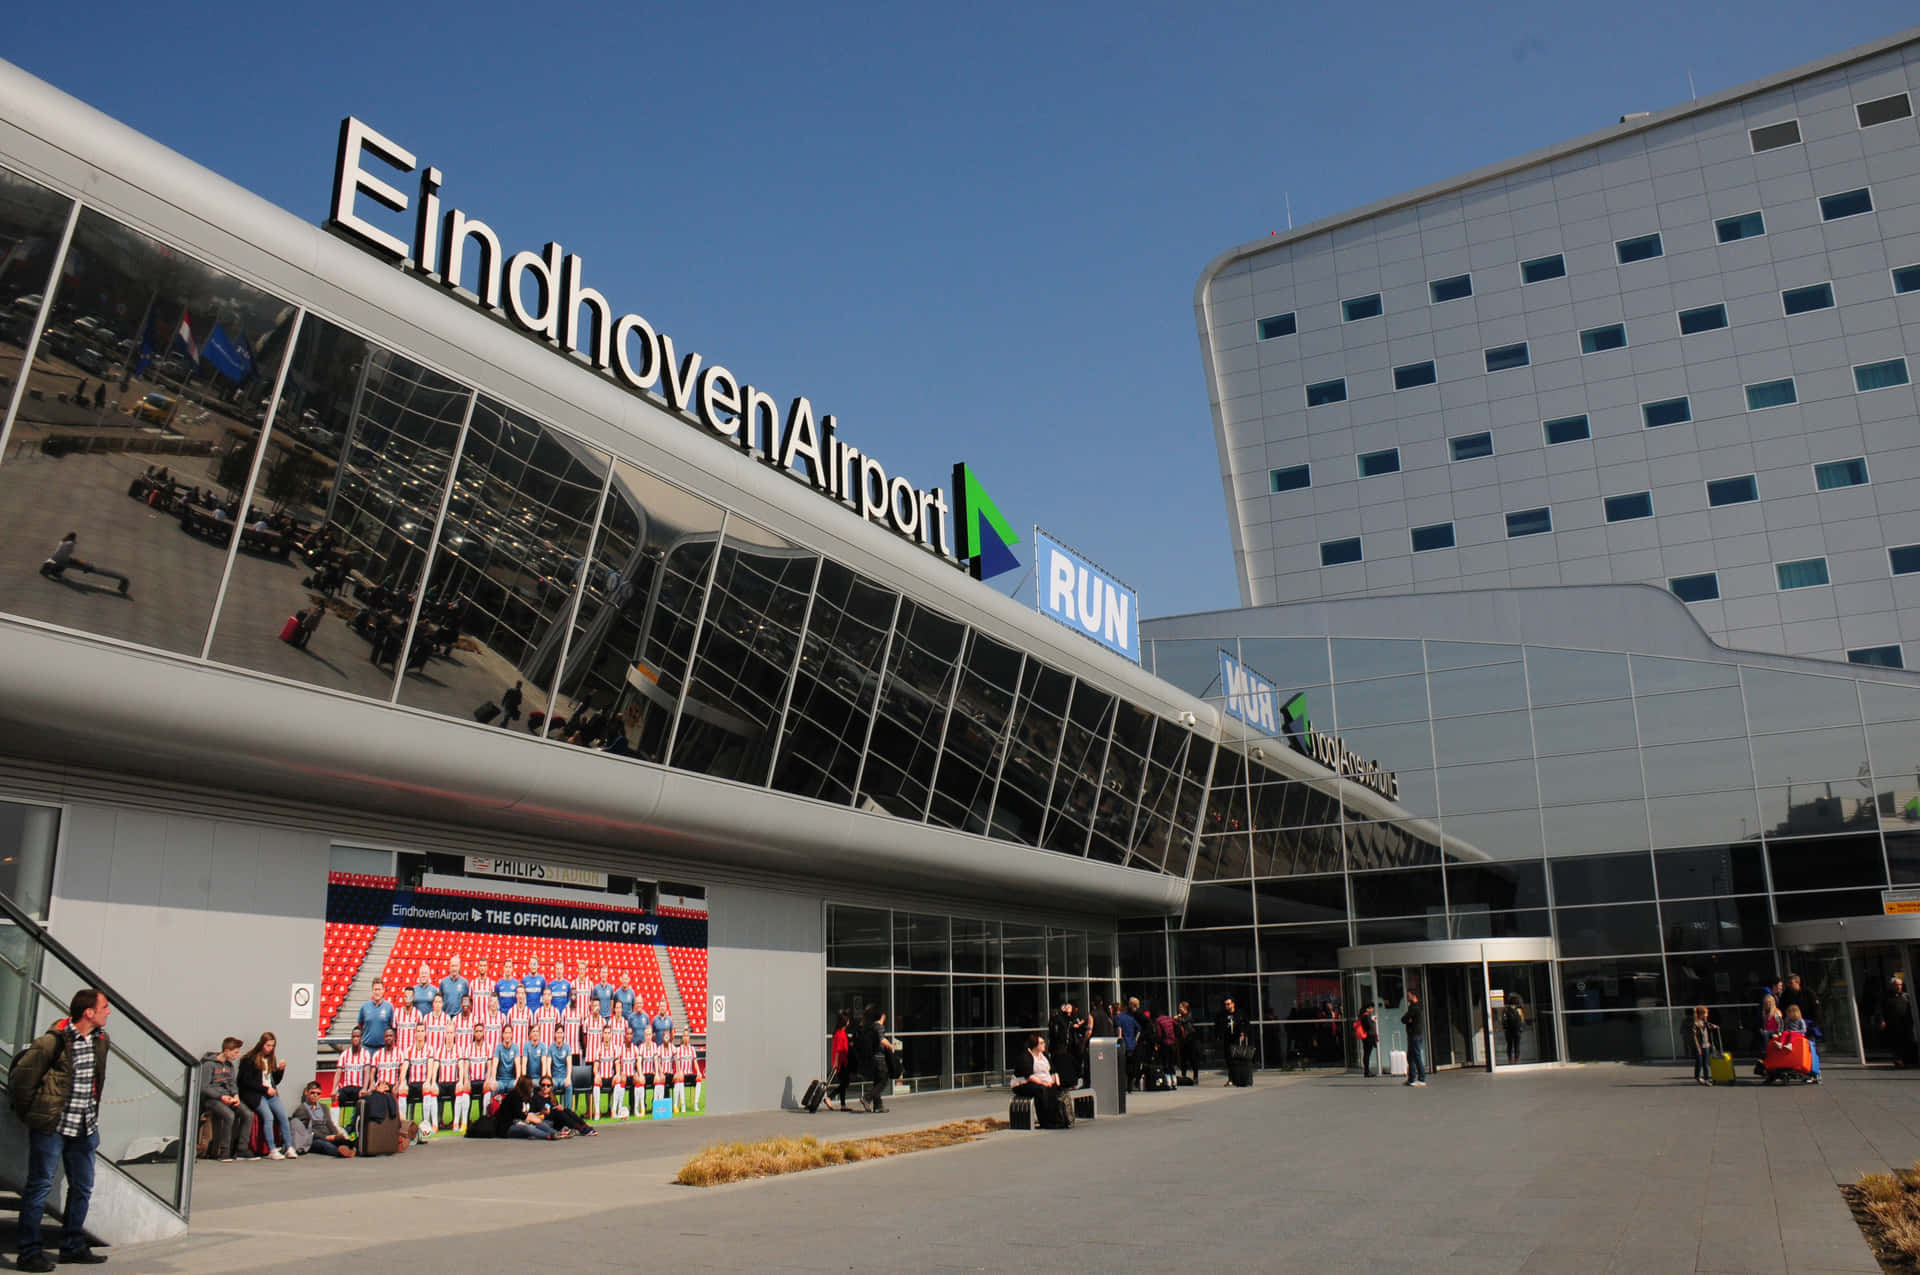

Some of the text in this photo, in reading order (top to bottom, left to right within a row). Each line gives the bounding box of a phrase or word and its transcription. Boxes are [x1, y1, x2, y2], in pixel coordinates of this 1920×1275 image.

[328, 115, 949, 557] EindhovenAirport
[1050, 549, 1129, 651] RUN
[494, 859, 545, 879] PHILIPS
[392, 904, 658, 937] EindhovenAirport THE OFFICIAL AIRPORT OF PSV
